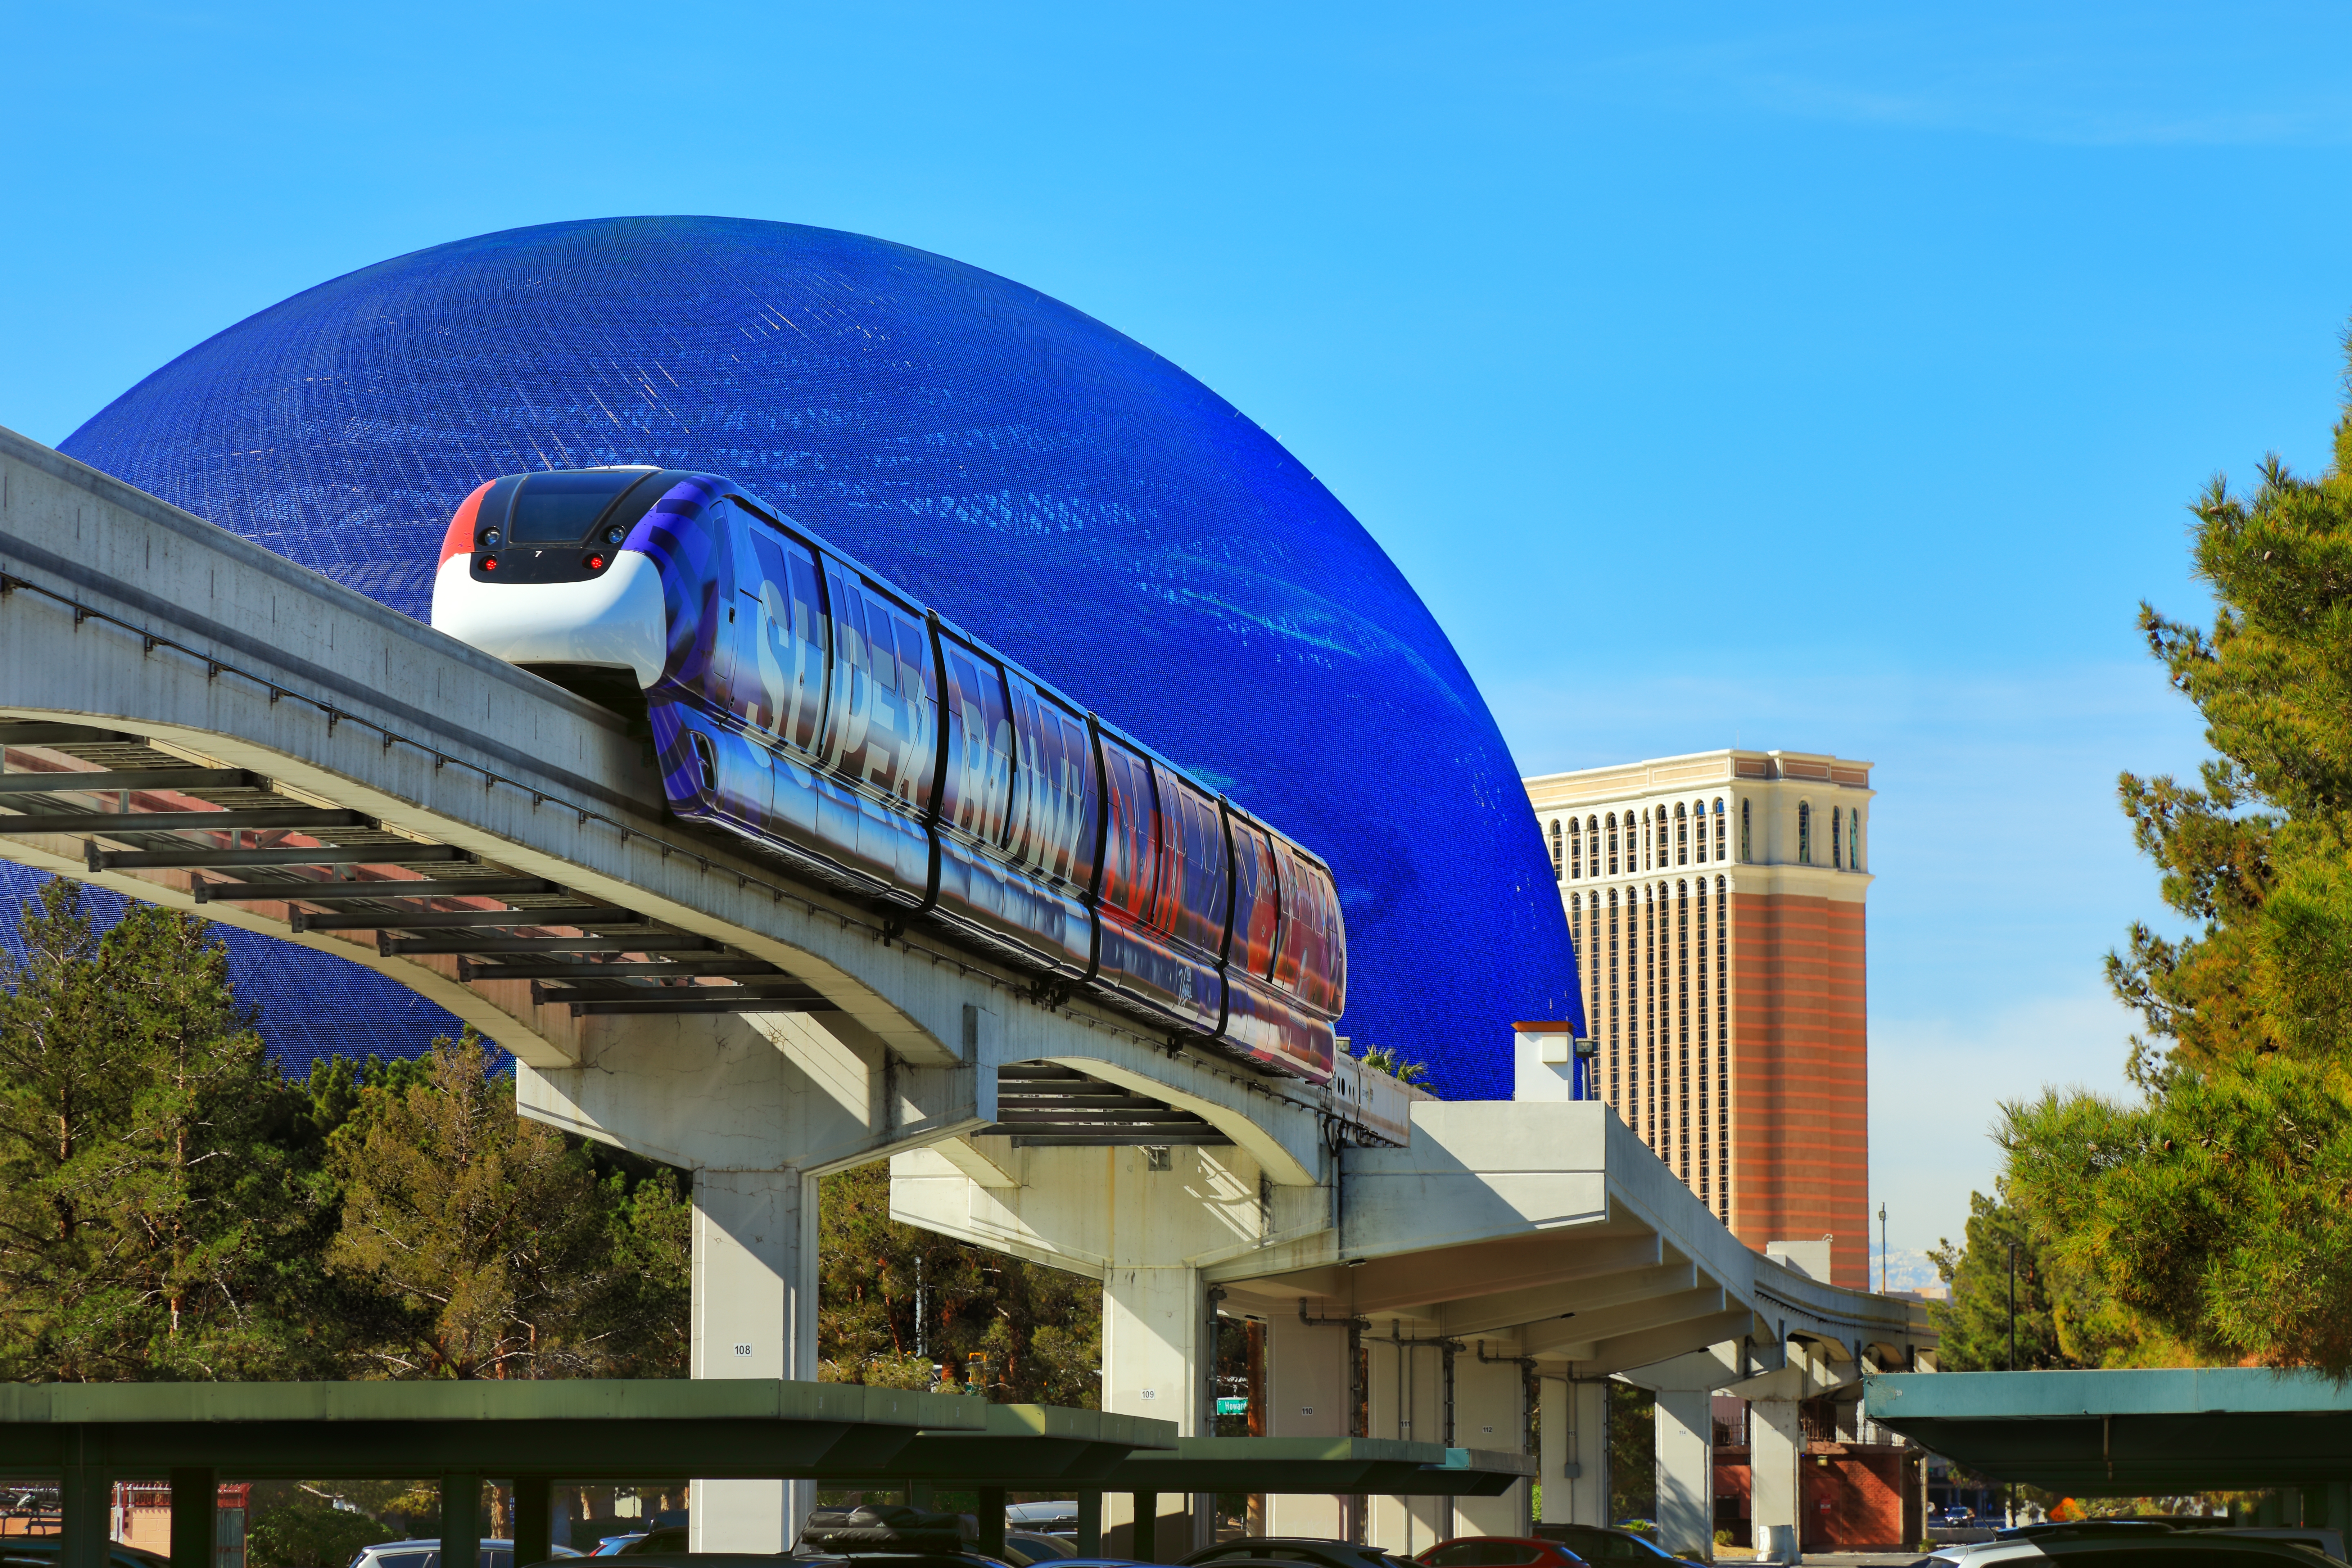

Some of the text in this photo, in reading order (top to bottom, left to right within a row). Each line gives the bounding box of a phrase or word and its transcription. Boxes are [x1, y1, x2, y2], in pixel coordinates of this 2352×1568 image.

[741, 579, 930, 840] SUPER
[947, 699, 1083, 919] BOWL
[734, 1345, 750, 1355] 108
[1225, 1401, 1247, 1410] Howard
